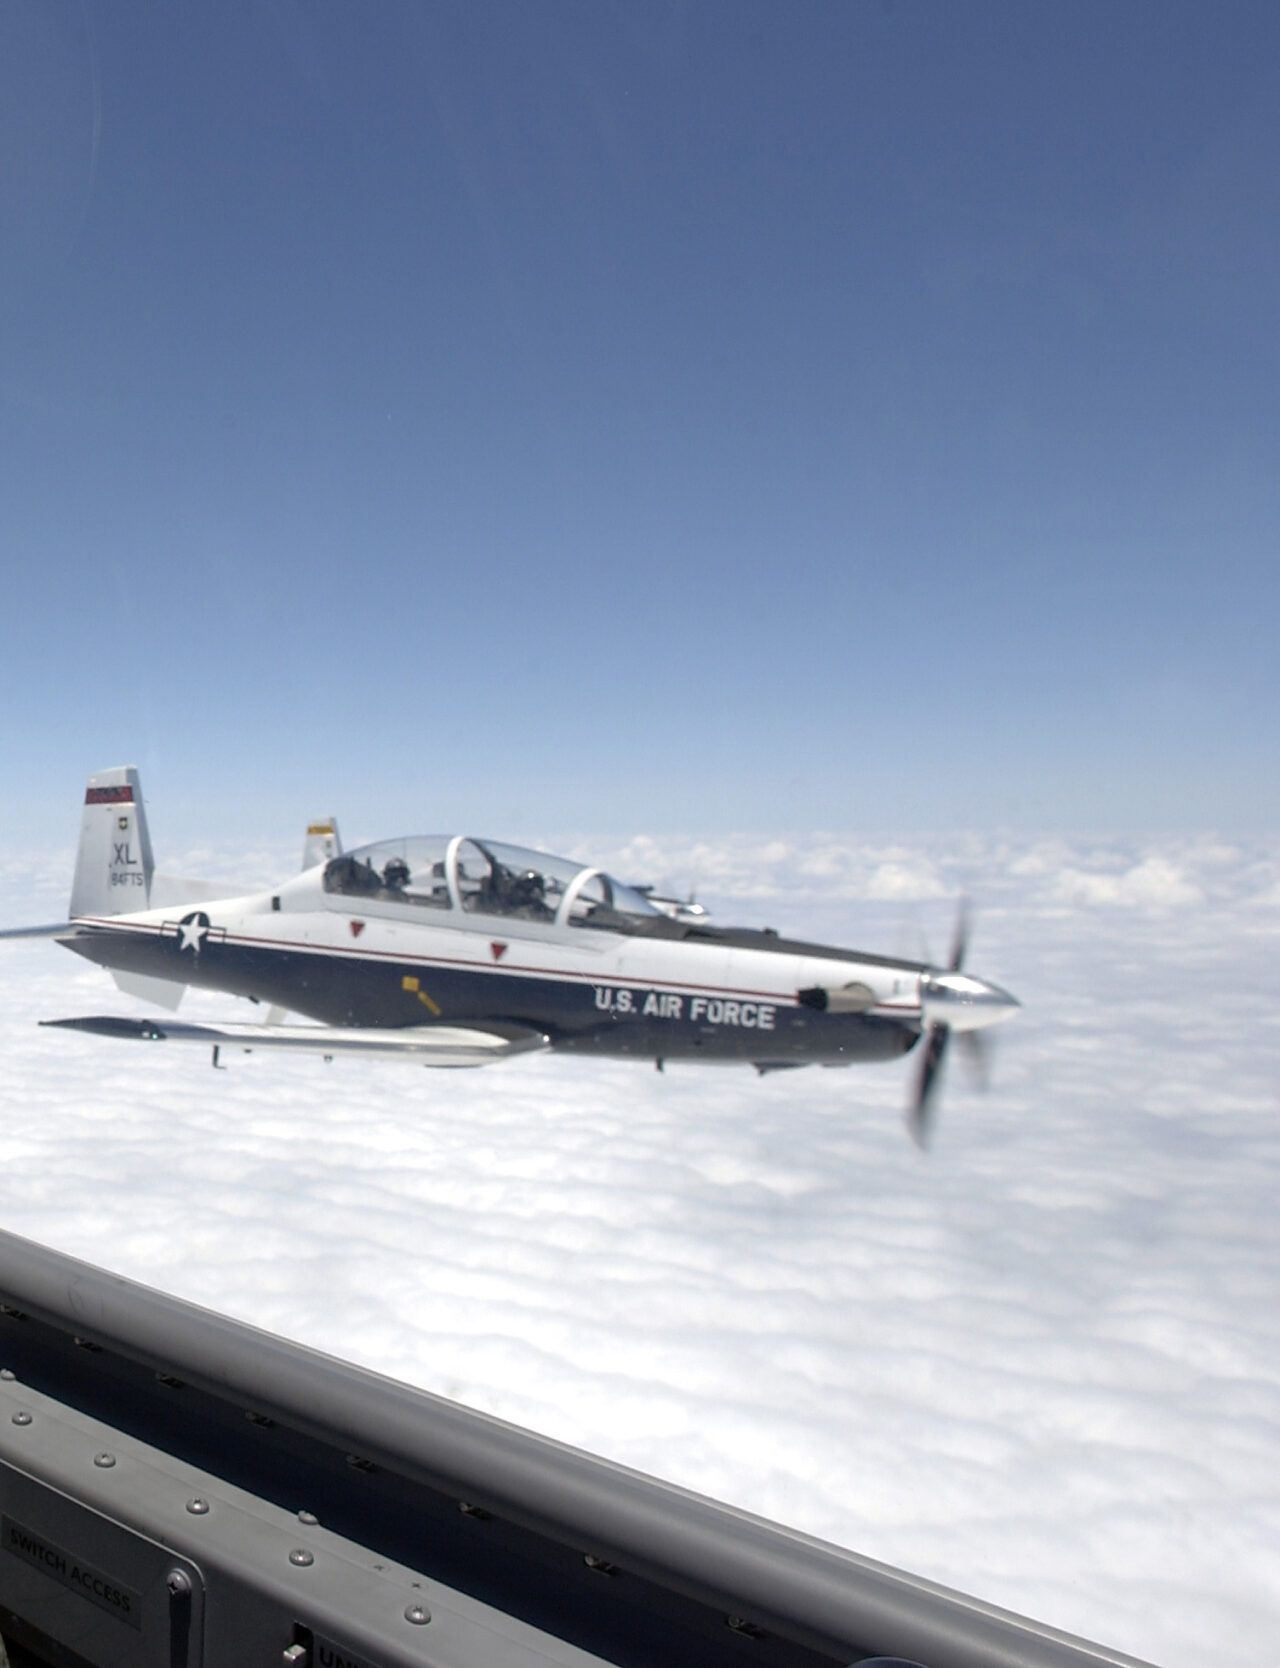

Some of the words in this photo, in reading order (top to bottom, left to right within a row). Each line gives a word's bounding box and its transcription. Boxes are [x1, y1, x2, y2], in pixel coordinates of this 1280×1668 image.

[113, 842, 138, 865] XL
[594, 986, 637, 1013] U.S.
[643, 993, 683, 1020] AIR
[689, 998, 777, 1030] FORCE
[10, 1528, 66, 1576] SWITCH
[70, 1565, 130, 1612] ACCESS
